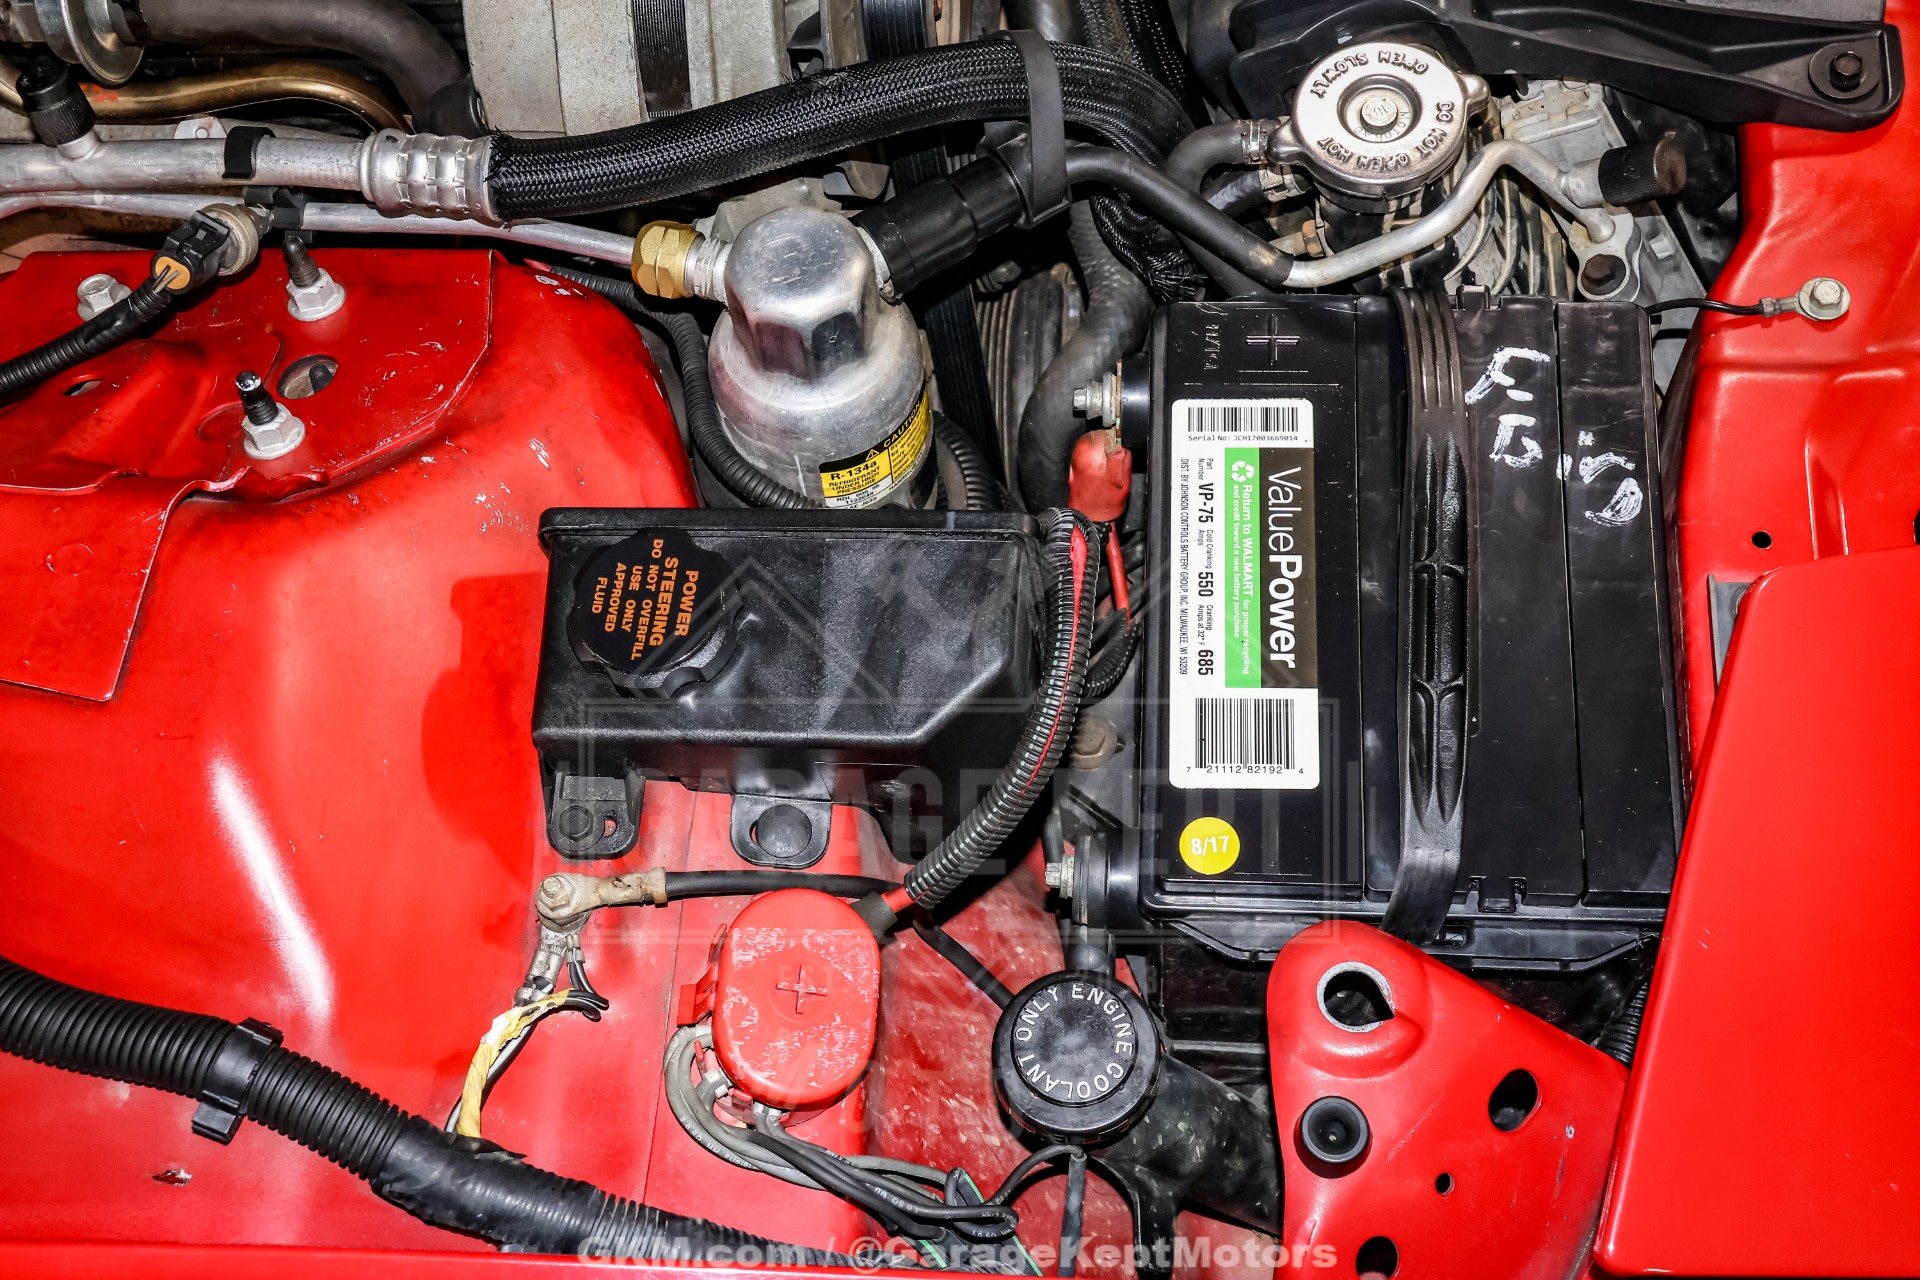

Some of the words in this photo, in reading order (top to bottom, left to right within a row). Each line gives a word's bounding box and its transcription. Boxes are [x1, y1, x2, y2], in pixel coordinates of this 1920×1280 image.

[1310, 52, 1369, 99] SLOWLY
[1378, 50, 1429, 75] OPEN
[1436, 101, 1454, 123] DO
[1317, 137, 1353, 163] HOT
[1415, 128, 1447, 158] NOT
[1357, 153, 1410, 172] OPEN
[883, 400, 921, 448] CAUTION
[828, 466, 881, 487] REFRIGERANT
[830, 461, 877, 481] R-134a
[1197, 458, 1205, 480] Number
[1206, 458, 1214, 470] Part
[832, 480, 860, 491] UNDER
[837, 478, 876, 494] PRESSURE
[1180, 474, 1189, 482] BY
[1180, 483, 1189, 511] JOHNSON
[1198, 482, 1214, 523] VP-75
[1242, 484, 1253, 520] Return
[1180, 511, 1189, 543] CONTROLS
[1197, 529, 1205, 546] Amps
[1206, 529, 1214, 543] Cold
[1243, 523, 1252, 535] to
[651, 539, 664, 559] DO
[1180, 544, 1189, 571] BATTERY
[1204, 543, 1214, 569] Cranking
[629, 565, 643, 591] USE
[645, 564, 659, 592] NOT
[1243, 538, 1254, 597] WALMART
[1268, 466, 1303, 669] ValuePower
[591, 577, 608, 614] FLUID
[604, 562, 627, 632] APPROVED
[1197, 571, 1214, 597] 550
[1232, 574, 1240, 601] battery
[649, 557, 679, 646] STEERING
[674, 570, 699, 637] POWER
[1196, 604, 1205, 622] Amps
[1242, 599, 1250, 610] for
[621, 599, 636, 632] ONLY
[1204, 604, 1214, 630] Cranking
[1232, 602, 1241, 638] purchase
[1241, 612, 1249, 637] proper
[631, 599, 653, 660] OVERFILL
[1179, 646, 1188, 655] WI
[1197, 649, 1214, 676] 685
[1241, 639, 1251, 675] recycling
[1206, 765, 1242, 774] 21112
[1247, 765, 1283, 775] 82192
[1299, 767, 1304, 775] 4
[1191, 835, 1229, 857] 8/17
[1015, 986, 1060, 1042] ONLY
[1071, 983, 1134, 1056] ENGINE
[1017, 1054, 1124, 1100] COOLANT
